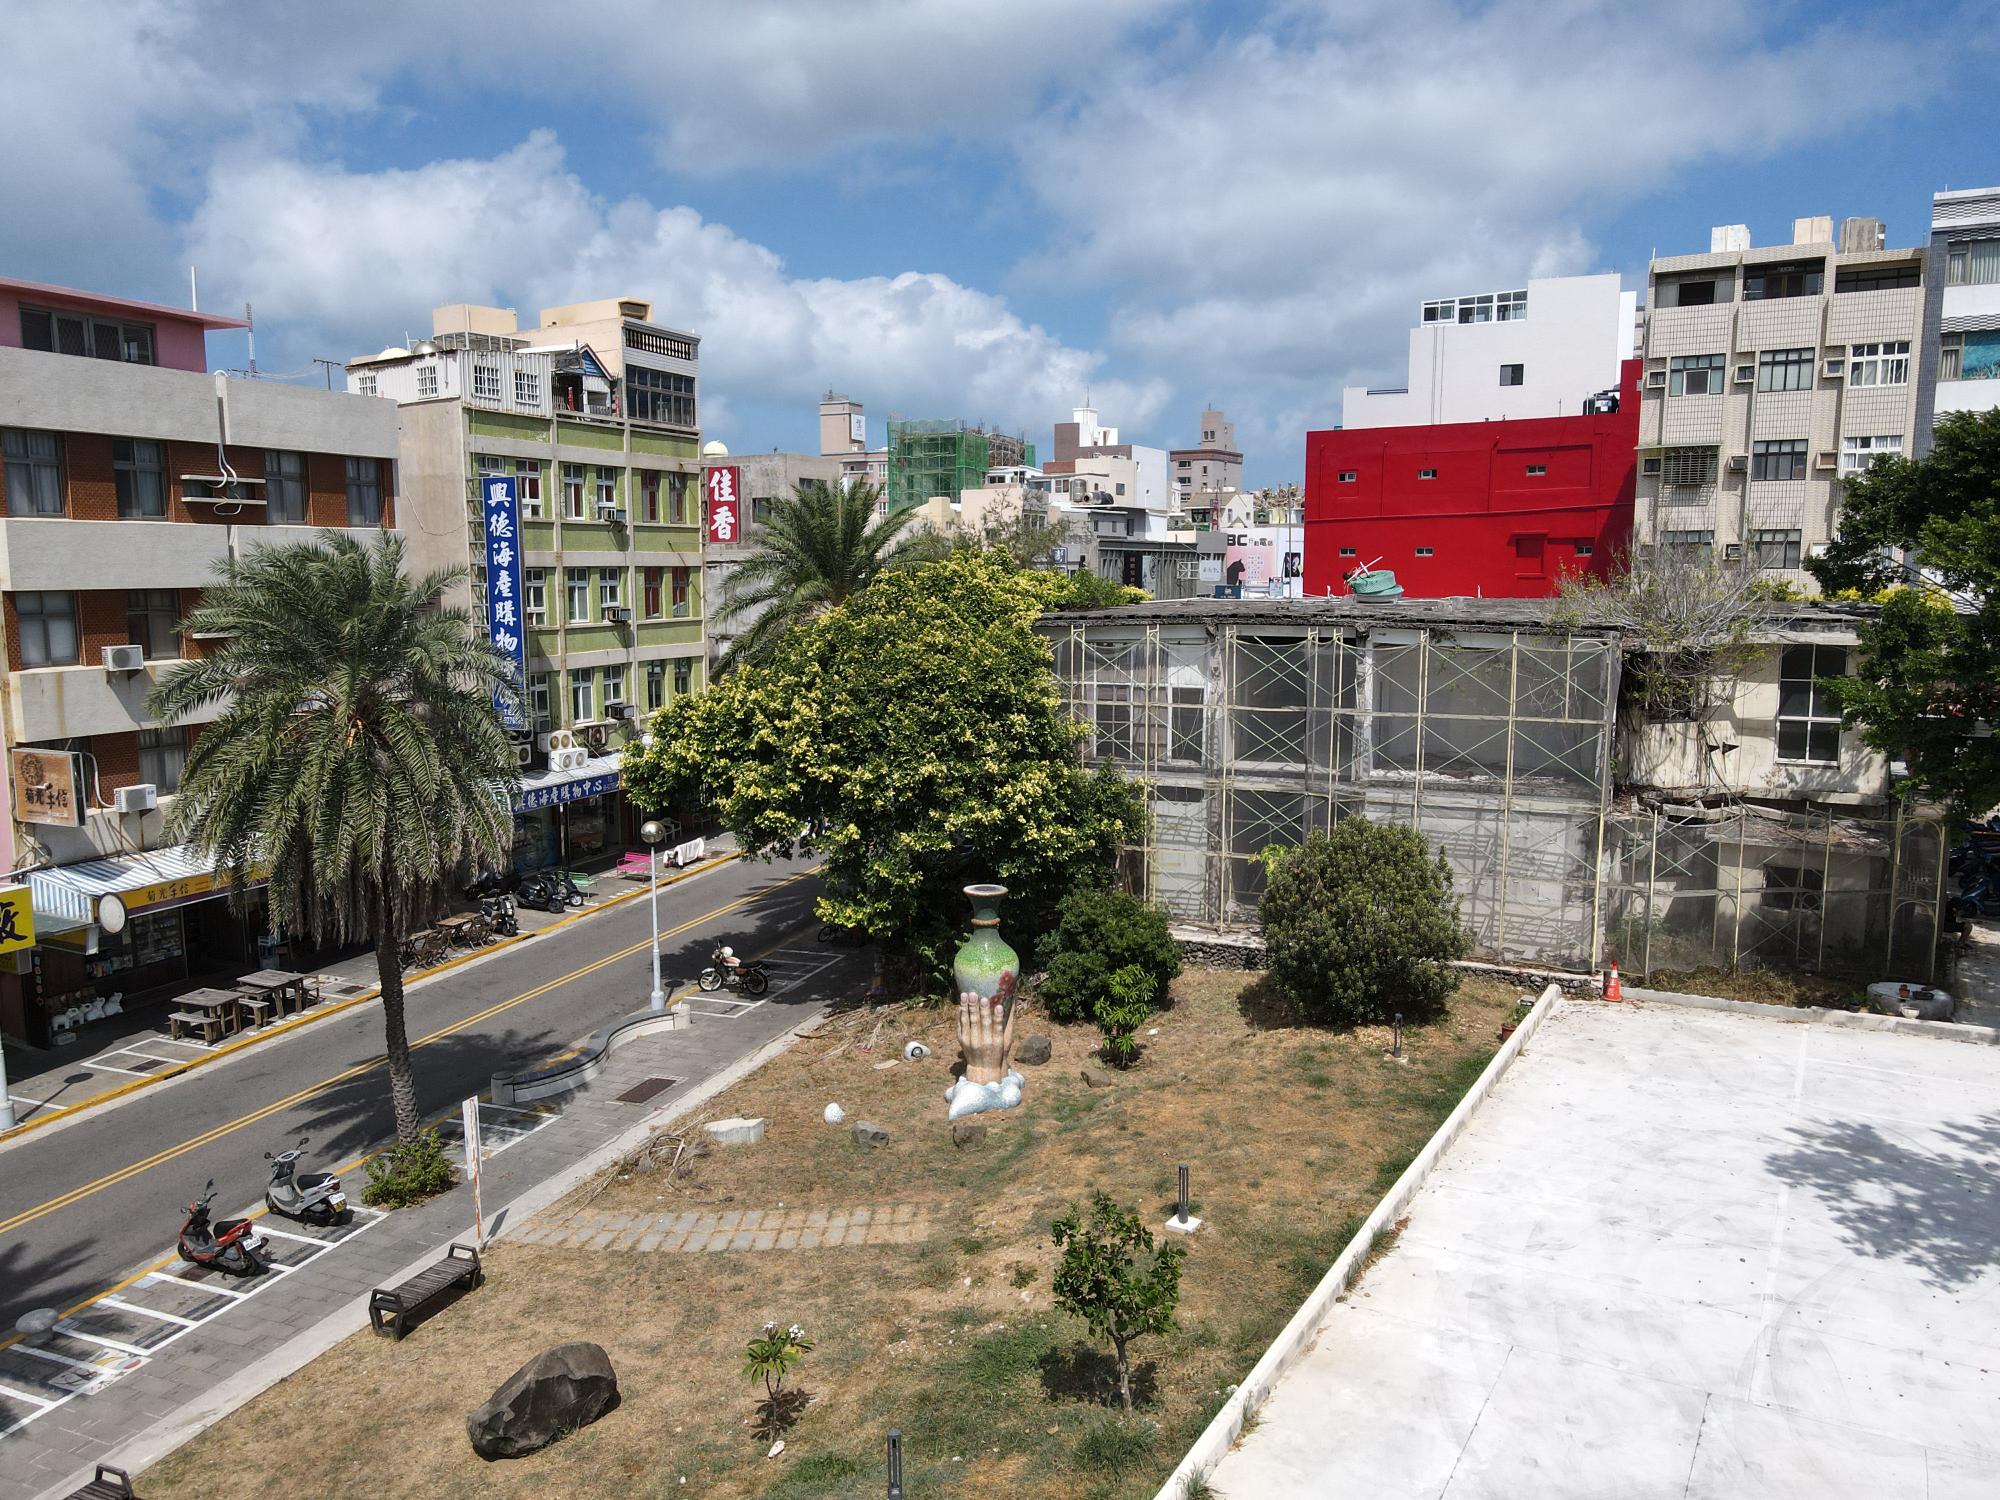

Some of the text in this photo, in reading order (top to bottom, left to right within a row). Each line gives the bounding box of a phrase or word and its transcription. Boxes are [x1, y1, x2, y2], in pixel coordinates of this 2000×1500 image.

[710, 469, 736, 540] 佳香
[487, 482, 520, 704] 興德海產購物
